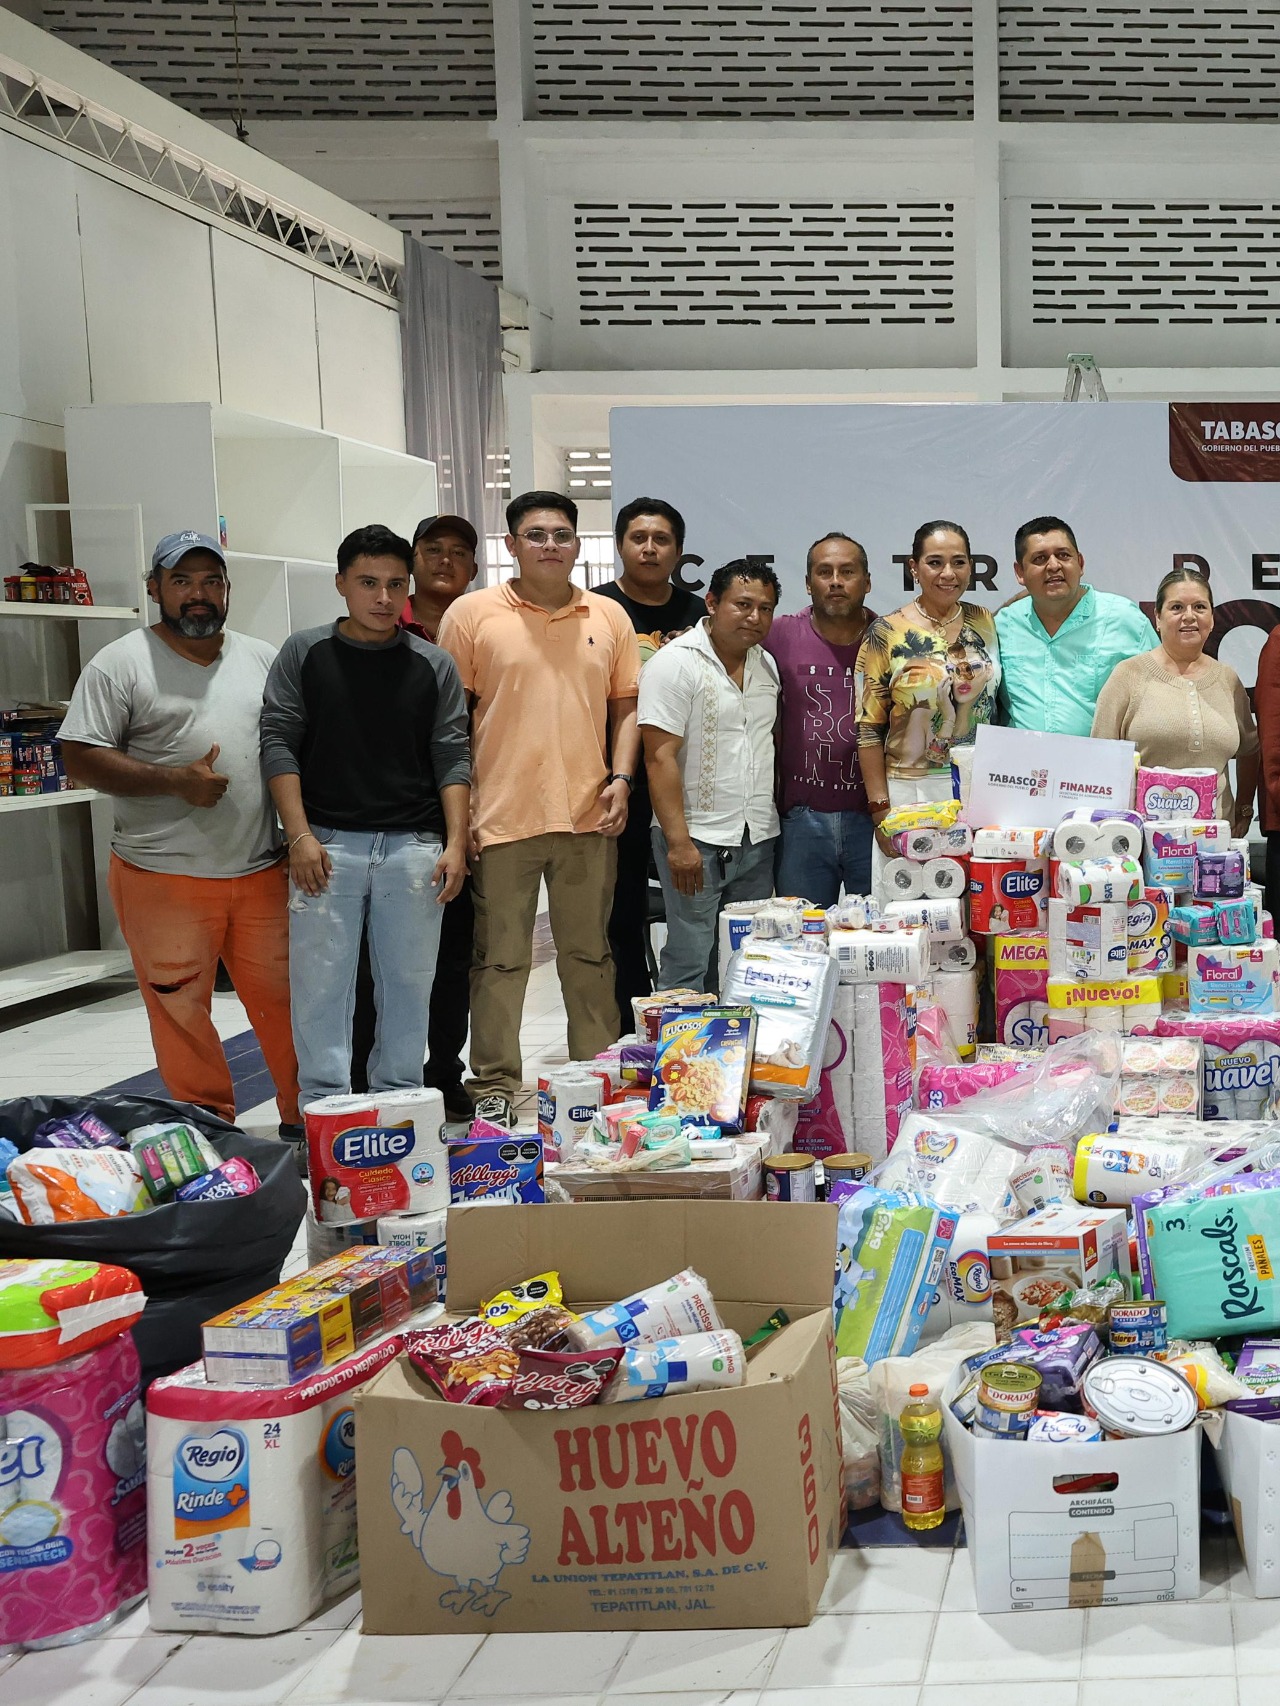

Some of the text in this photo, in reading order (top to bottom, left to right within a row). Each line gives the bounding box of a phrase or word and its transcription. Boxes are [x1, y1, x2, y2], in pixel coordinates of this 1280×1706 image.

[1201, 444, 1242, 452] GOBIERNO
[1244, 444, 1258, 452] DEL
[988, 773, 1113, 796] TABASCO FINANZAS
[1147, 793, 1193, 811] Suavel
[1207, 825, 1215, 833] 4
[1162, 845, 1194, 857] Floral
[1006, 873, 1040, 893] Elite
[1126, 907, 1151, 927] egio
[1001, 945, 1048, 961] MEGA
[1205, 968, 1239, 981] Floral
[1066, 985, 1140, 1006] ¡Nuevo!
[665, 1021, 703, 1037] ZUCOSOS
[1220, 1056, 1252, 1066] NUEVO
[572, 1108, 595, 1119] Elite
[343, 1129, 407, 1162] Elite
[358, 1167, 394, 1178] Cuidado
[362, 1175, 392, 1183] Clásico
[451, 1164, 519, 1187] Kellogg's
[1165, 1217, 1186, 1232] 3
[1244, 1245, 1256, 1271] PREMIUM
[1252, 1238, 1271, 1276] PAÑALES
[1200, 1213, 1266, 1320] Rascals
[949, 1261, 966, 1303] EcoMAX
[972, 1266, 982, 1290] Regio
[1112, 1308, 1148, 1317] DORADO
[301, 1343, 396, 1399] PRODUCTO MEJORADO
[992, 1391, 1034, 1402] DORADO
[263, 1422, 281, 1436] 24
[264, 1438, 281, 1450] XL
[554, 1409, 737, 1493] HUEVO
[187, 1444, 238, 1467] Regio
[798, 1412, 820, 1566] 360
[177, 1489, 224, 1513] Rinde
[1070, 1497, 1113, 1507] ARCHIFÁCIL
[1071, 1507, 1113, 1516] CONTENIDO
[556, 1476, 756, 1566] ALTEÑO
[183, 1543, 195, 1557] 2
[532, 1561, 768, 1583] LA UNION TEPATITLAN, S.A. DE C.V.
[591, 1600, 716, 1614] TEPATITLAN, JAL.
